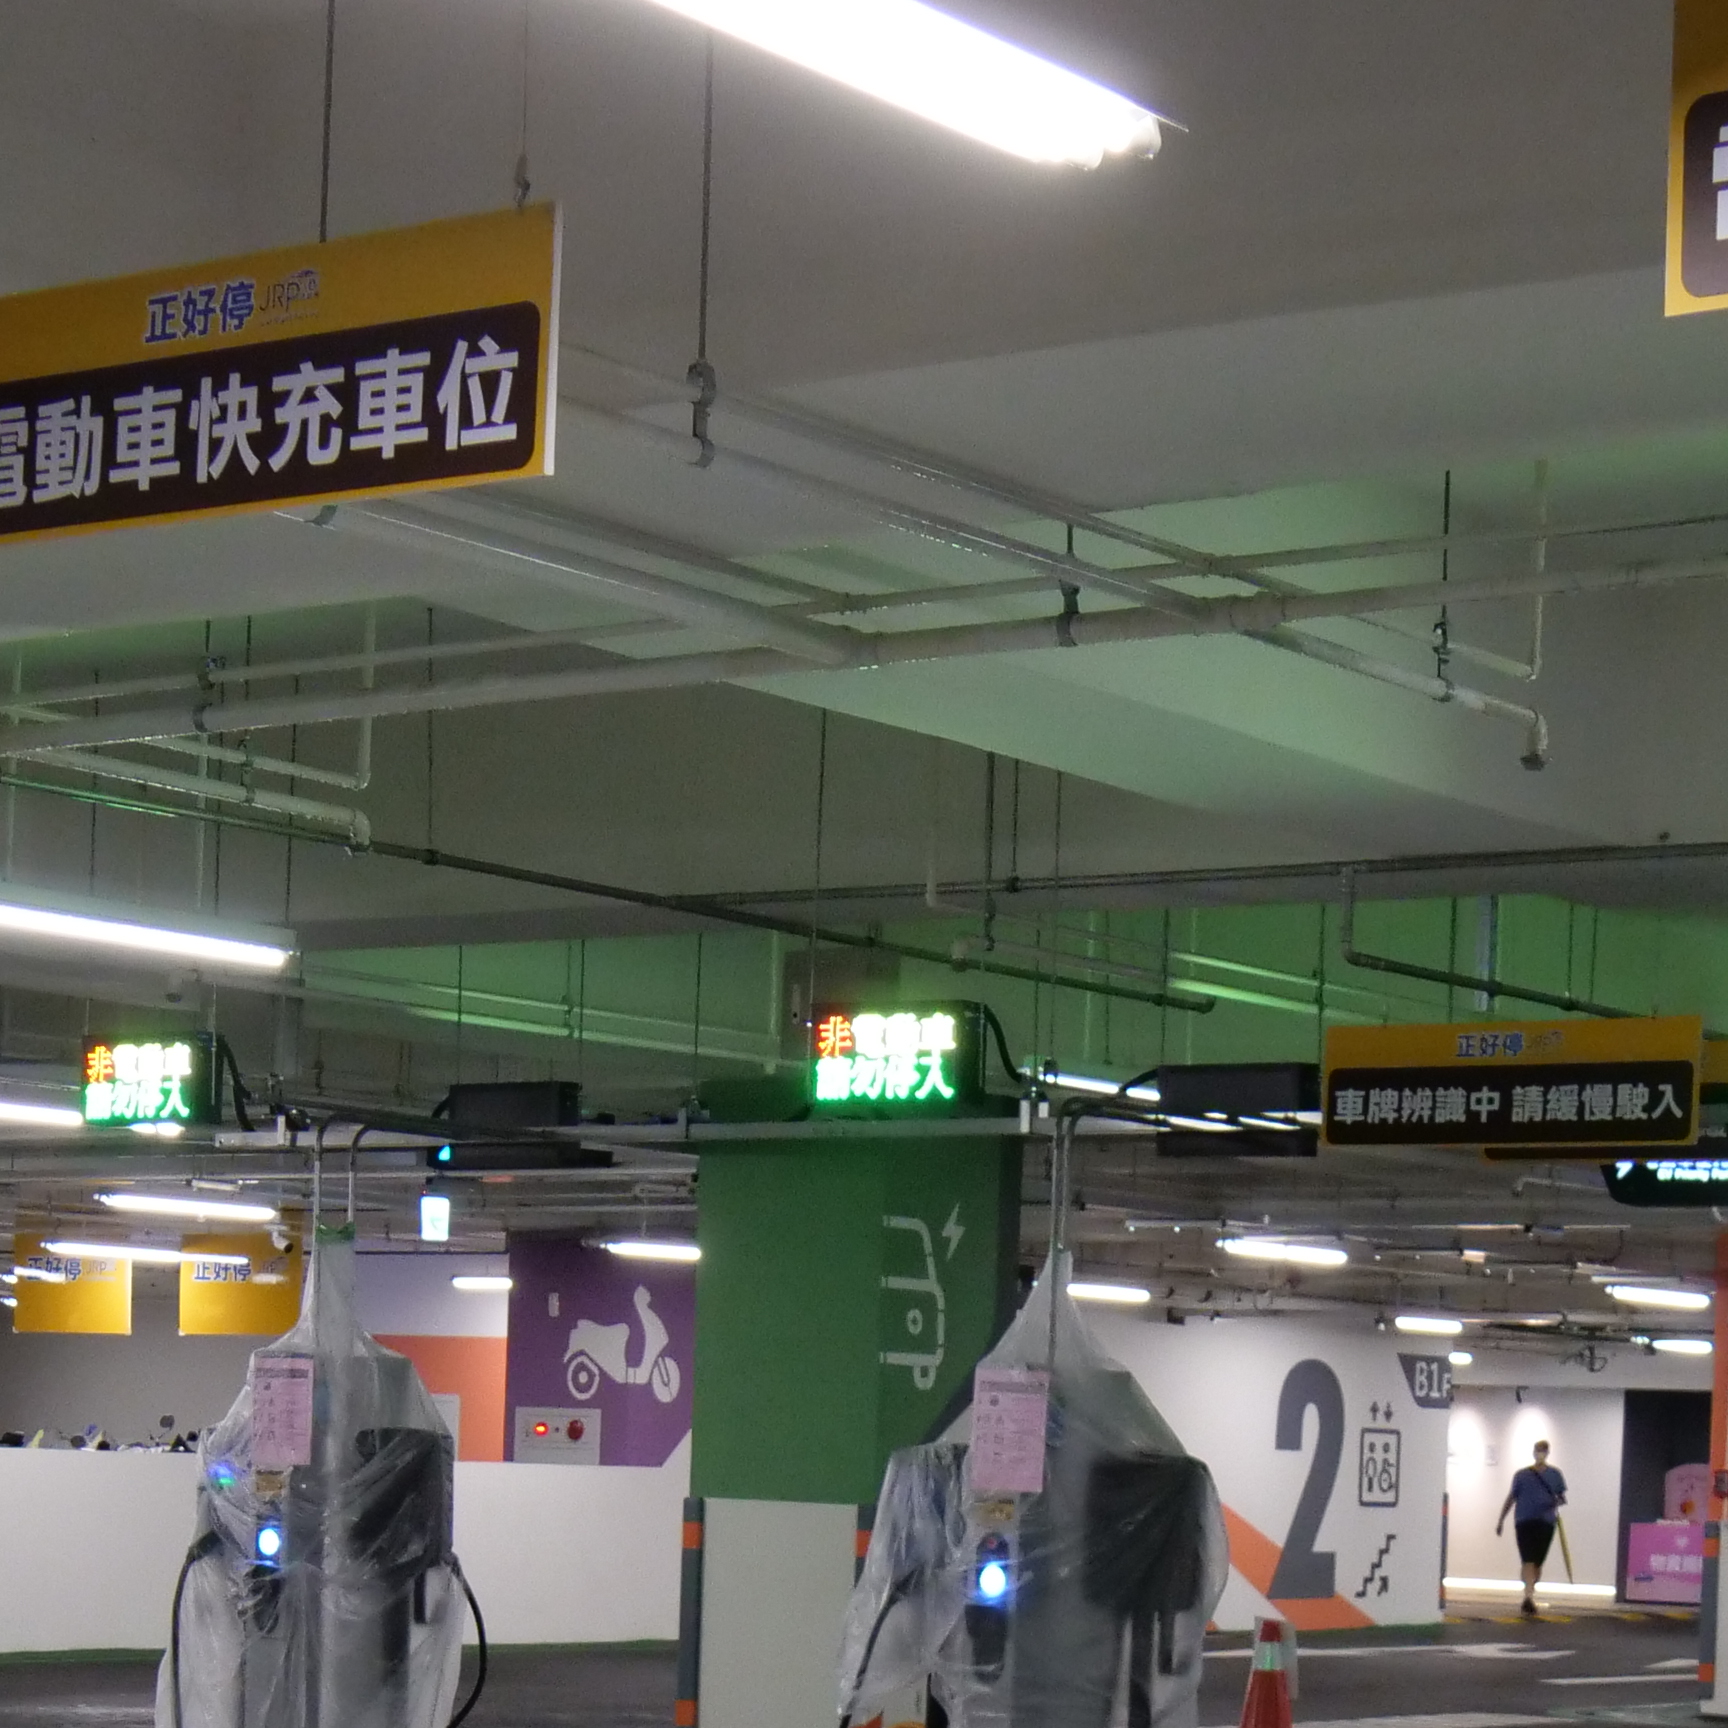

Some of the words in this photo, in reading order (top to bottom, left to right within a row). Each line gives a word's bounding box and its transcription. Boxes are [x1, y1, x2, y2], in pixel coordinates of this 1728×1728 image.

[144, 281, 256, 344] 正好停
[1455, 1032, 1523, 1058] 正好停
[1333, 1085, 1501, 1125] 車牌辨識中
[1511, 1082, 1684, 1123] 請緩慢駛入
[1415, 1361, 1452, 1398] B1F
[1267, 1358, 1345, 1600] 2
